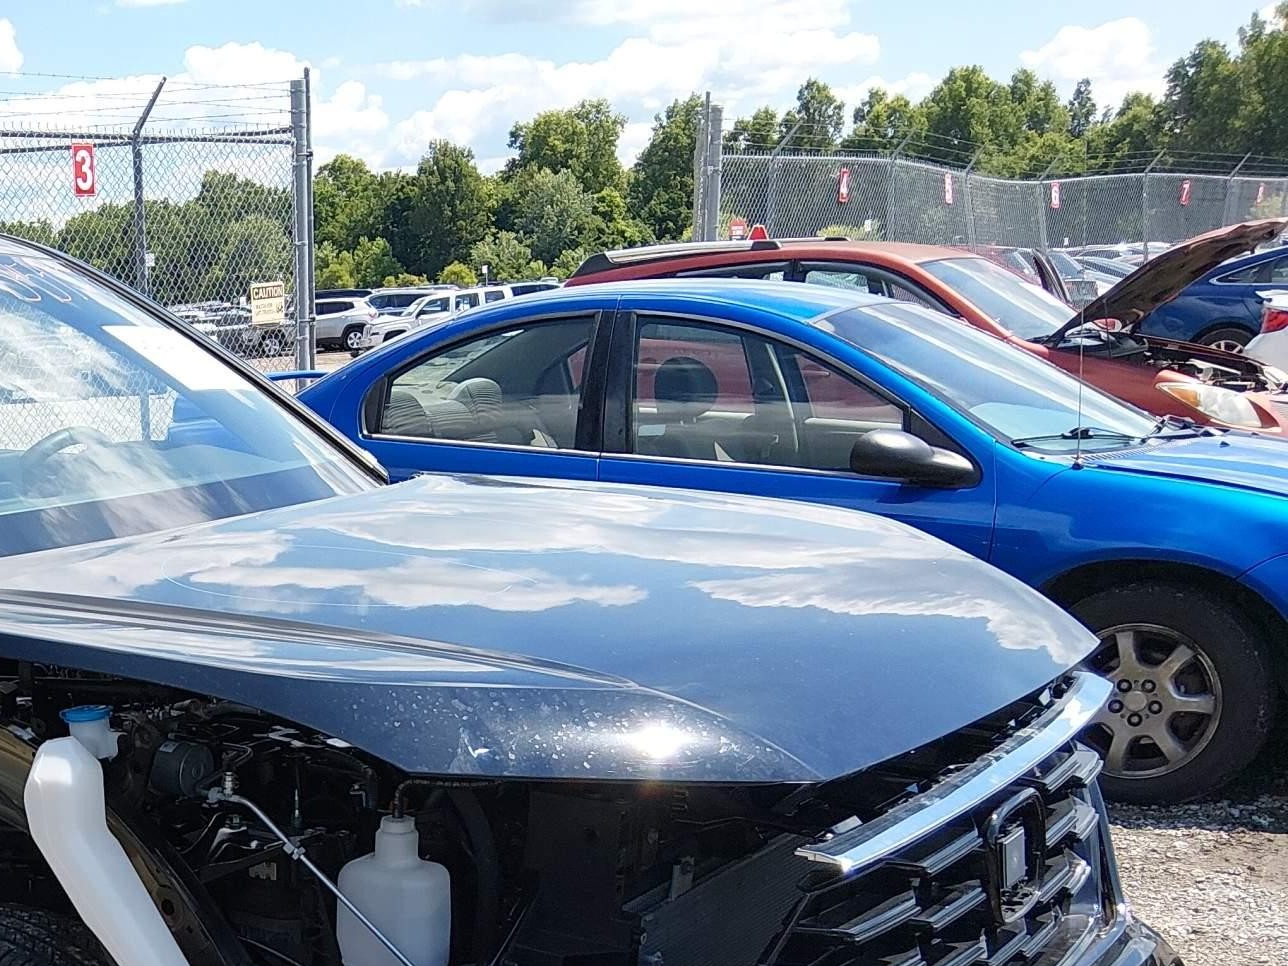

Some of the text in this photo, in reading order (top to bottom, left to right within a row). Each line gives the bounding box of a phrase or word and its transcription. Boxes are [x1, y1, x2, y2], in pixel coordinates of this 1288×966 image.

[75, 149, 93, 191] 3
[839, 172, 849, 198] 4
[253, 286, 283, 299] CAUTION
